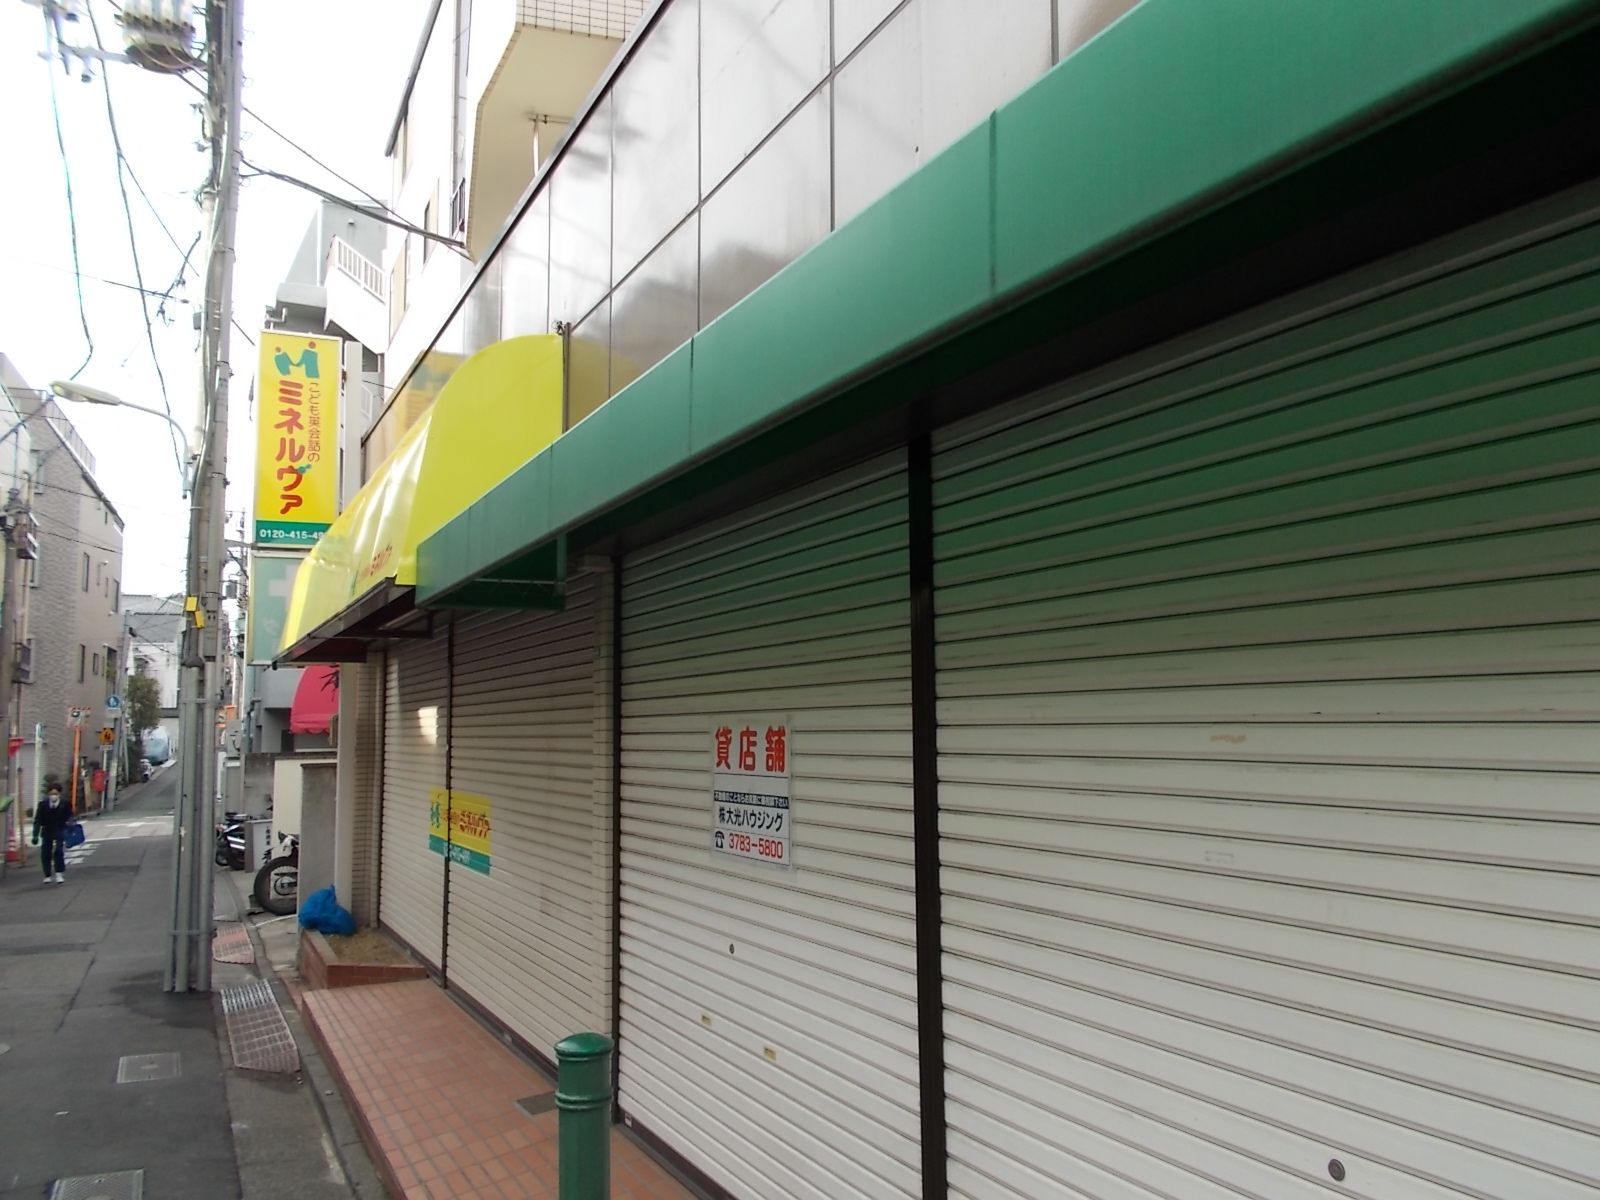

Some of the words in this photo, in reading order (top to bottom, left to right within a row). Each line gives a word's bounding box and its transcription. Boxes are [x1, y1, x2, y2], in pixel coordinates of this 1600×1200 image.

[274, 380, 309, 515] ミネルヴァ
[307, 382, 322, 462] こども英会話の
[715, 725, 786, 773] 貸店舗
[728, 833, 783, 859] 3783-5800
